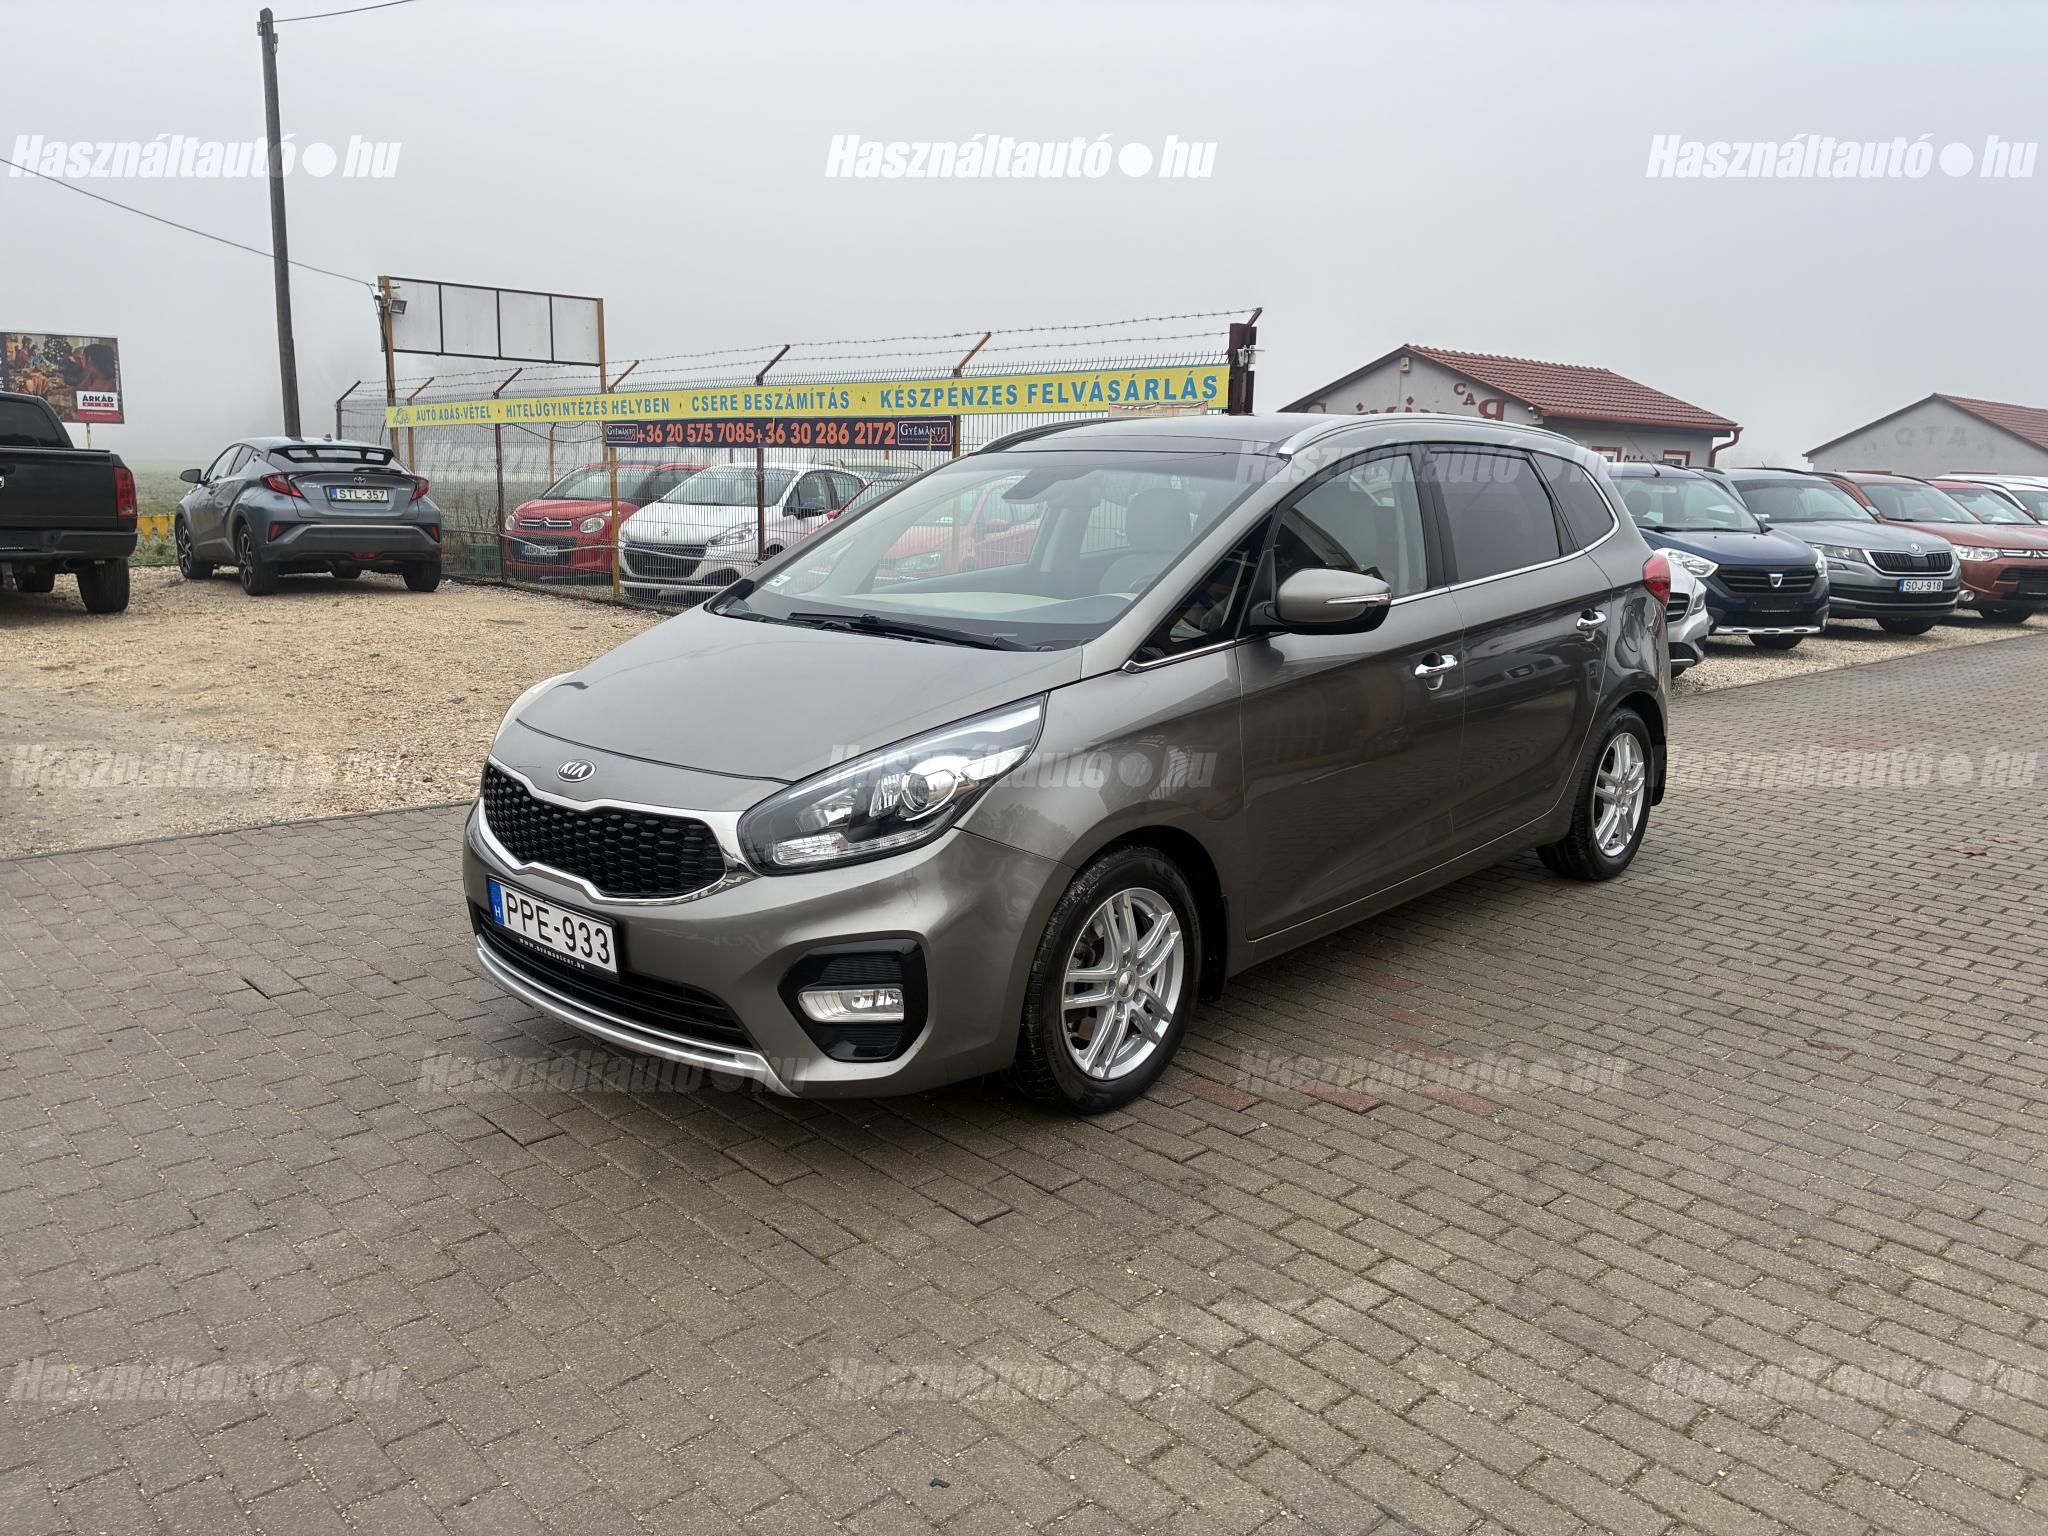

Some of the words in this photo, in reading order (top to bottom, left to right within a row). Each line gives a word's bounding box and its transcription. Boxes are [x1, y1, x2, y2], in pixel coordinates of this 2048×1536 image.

[416, 406, 437, 422] AUTÓ
[612, 397, 670, 415] HELYBEN
[691, 393, 739, 412] CSERE
[743, 386, 850, 411] BESZÁMÍTÁS
[880, 382, 1018, 409] KÉSZPÉNZES
[1027, 370, 1219, 405] FELVÁSÁRLÁS
[638, 423, 663, 444] +36
[666, 423, 683, 444] 20
[686, 422, 714, 443] 575
[717, 422, 755, 444] 7085
[756, 421, 786, 445] +36
[790, 422, 812, 445] 30
[815, 421, 850, 445] 286
[854, 421, 897, 445] 2172
[339, 489, 385, 500] STL-357
[559, 761, 589, 778] KIA
[494, 904, 501, 918] H
[505, 890, 610, 965] PPE-933
